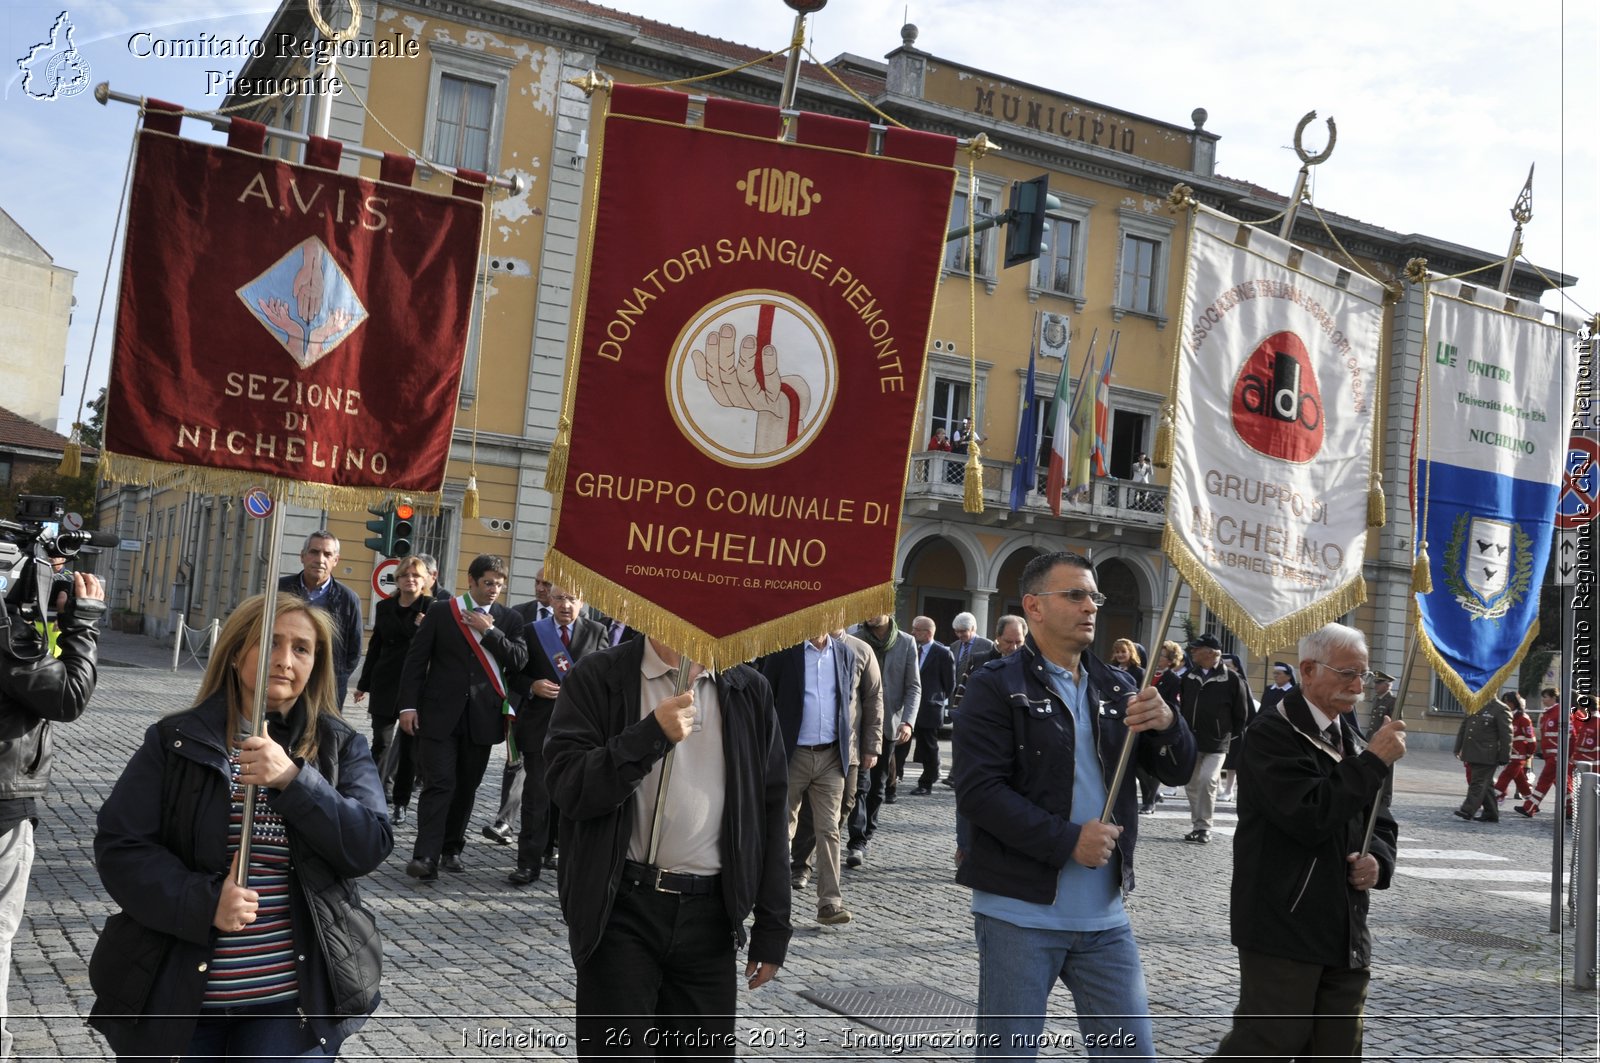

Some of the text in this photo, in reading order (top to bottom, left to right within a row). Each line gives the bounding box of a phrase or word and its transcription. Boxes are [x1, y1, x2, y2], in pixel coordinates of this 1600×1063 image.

[974, 86, 1135, 154] MUNICIPIO
[237, 172, 394, 233] A.V.I.S.
[745, 168, 814, 216] FIDAS
[598, 236, 904, 393] DONATORI SANGUE PIEMONTE
[225, 372, 361, 415] SEZIONE
[1242, 361, 1320, 430] aido
[1467, 359, 1511, 384] UNITRE
[286, 412, 308, 431] DI
[1516, 407, 1529, 420] Tre
[177, 424, 388, 475] NICHELINO
[1469, 428, 1535, 455] NICHELINO
[575, 472, 889, 526] GRUPPO COMUNALE DI
[1205, 469, 1328, 526] GRUPPO DI
[627, 521, 826, 568] NICHELINO
[1191, 505, 1344, 571] NICHELINO
[625, 564, 822, 591] FONDATO DAL DOTT. G.B. PICCAROLO
